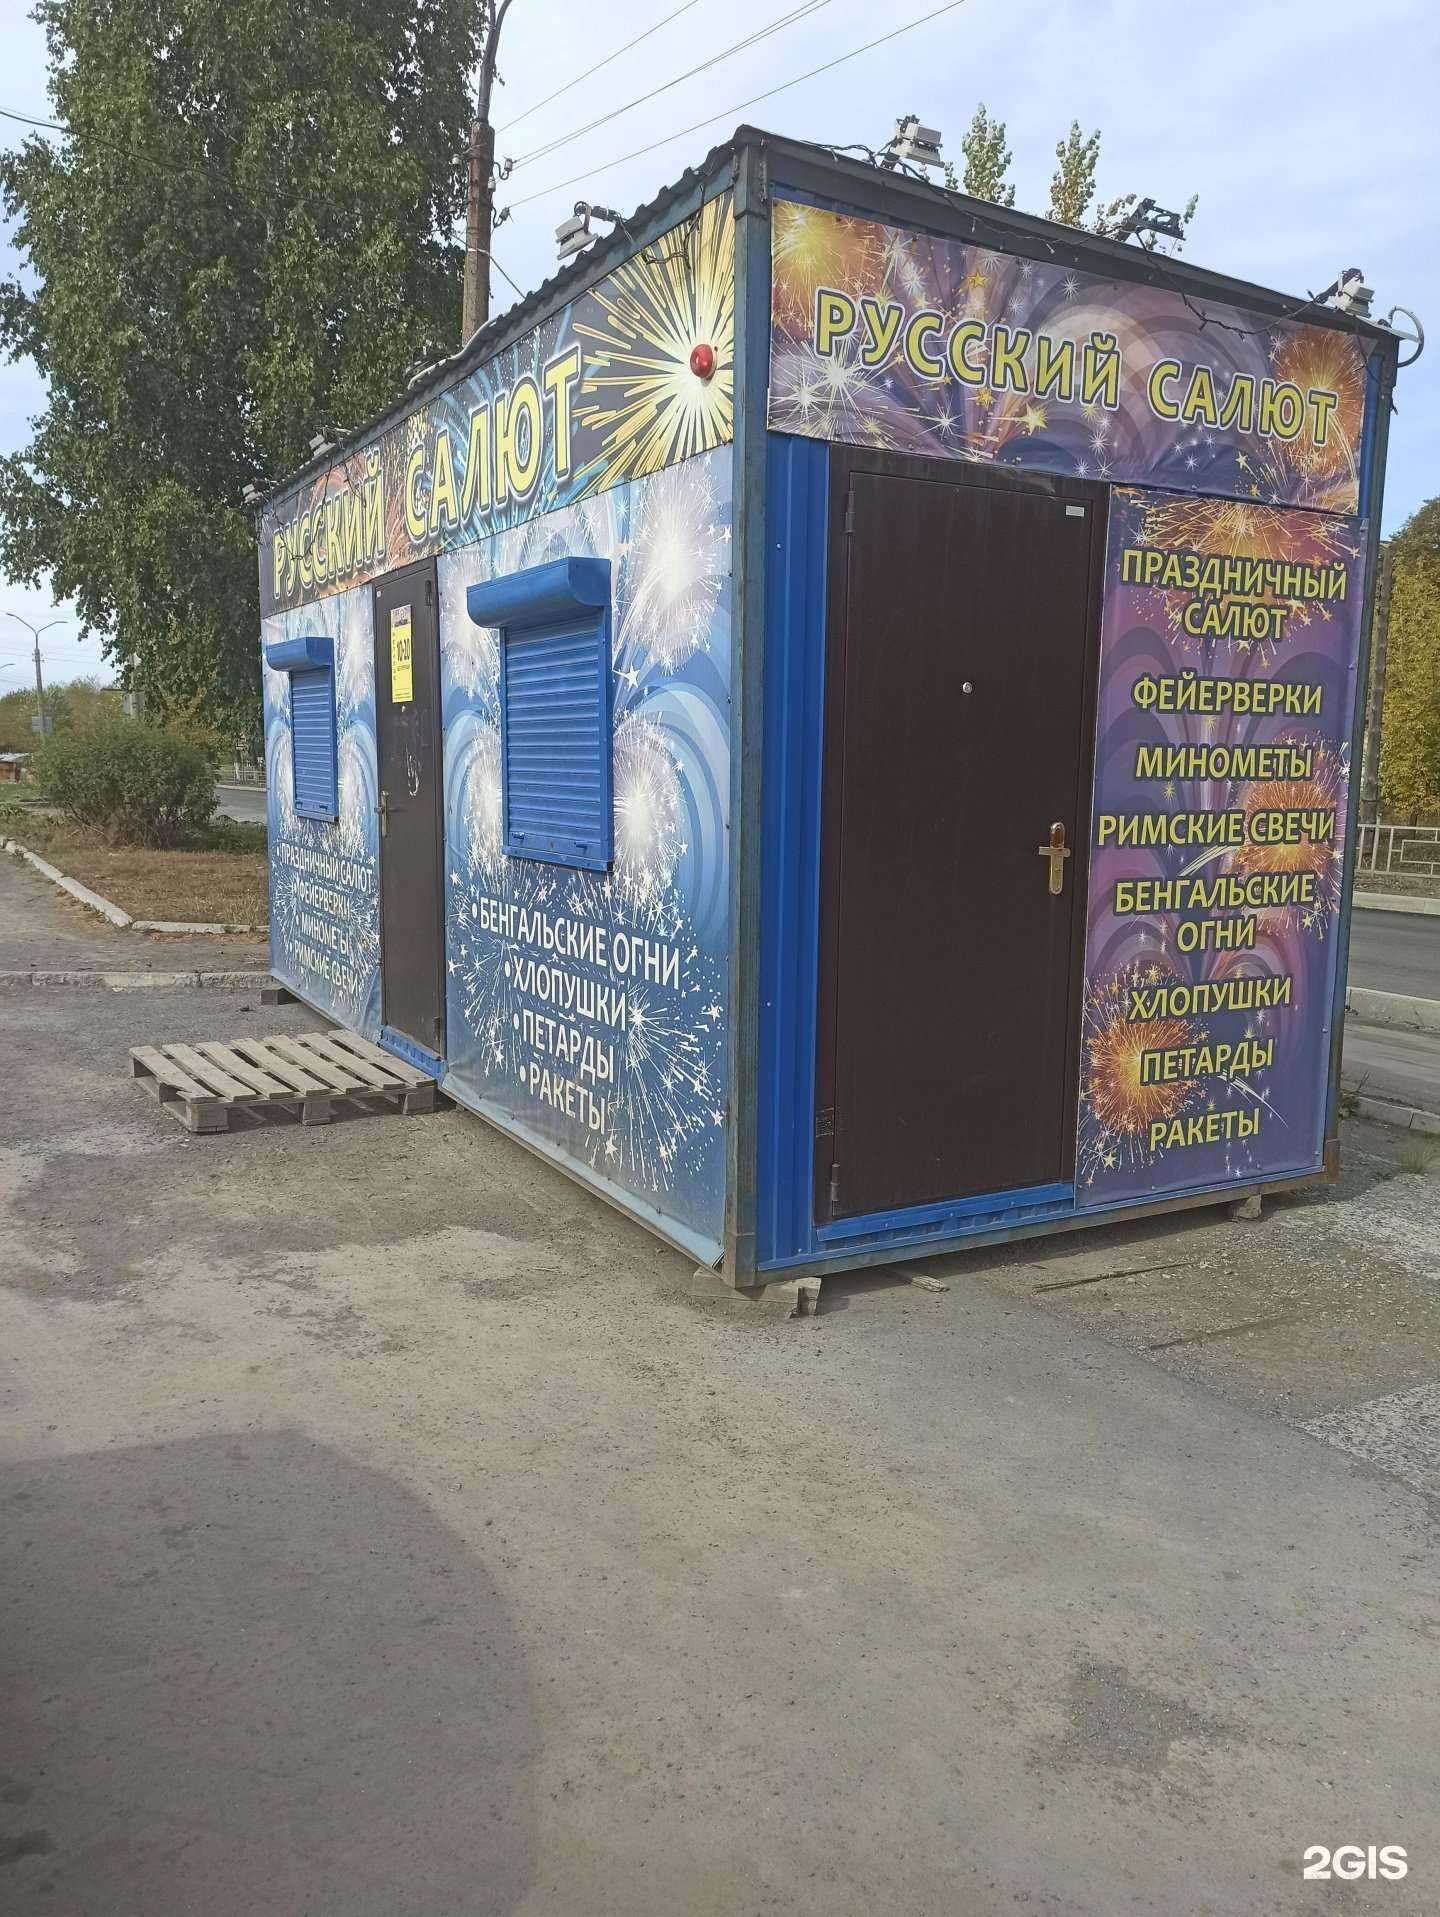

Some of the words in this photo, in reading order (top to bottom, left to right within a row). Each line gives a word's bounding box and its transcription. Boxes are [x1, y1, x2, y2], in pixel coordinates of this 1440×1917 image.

[814, 288, 1121, 408] РУССКИЙ
[1150, 361, 1338, 444] САЛЮТ
[273, 450, 385, 599] РУССКИЙ
[406, 345, 580, 541] САЛЮТ
[1121, 548, 1348, 601] ПРАЗДНИЧНЫЙ
[1183, 601, 1288, 640] САЛЮТ
[1132, 670, 1323, 715] ФЕЙЕРВЕРКИ
[1134, 745, 1312, 779] МИНОМЕТЫ
[1097, 813, 1243, 847] РИМСКИЕ
[1250, 811, 1335, 842] СВЕЧИ
[280, 842, 339, 883] ПРАЗДНИЧНЫЙ
[340, 860, 373, 895] САЛЮТ
[297, 876, 351, 921] ФЕЙЕРВЕРКИ
[1114, 873, 1315, 914] БЕНГАЛЬСКИЕ
[480, 897, 607, 967] БЕНГАЛЬСКИЕ
[612, 932, 680, 990] ОГНИ
[1175, 919, 1255, 952] ОГНИ
[293, 940, 330, 980] РИМСКИЕ
[331, 959, 359, 997] СВЕЧИ
[513, 955, 626, 1032] ХЛОПУШКИ
[1128, 977, 1292, 1020] ХЛОПУШКИ
[522, 1008, 614, 1087] ПЕТАРДЫ
[1141, 1039, 1273, 1082] ПЕТАРДЫ
[529, 1061, 605, 1135] РАКЕТЫ
[1150, 1107, 1260, 1152] РАКЕТЫ
